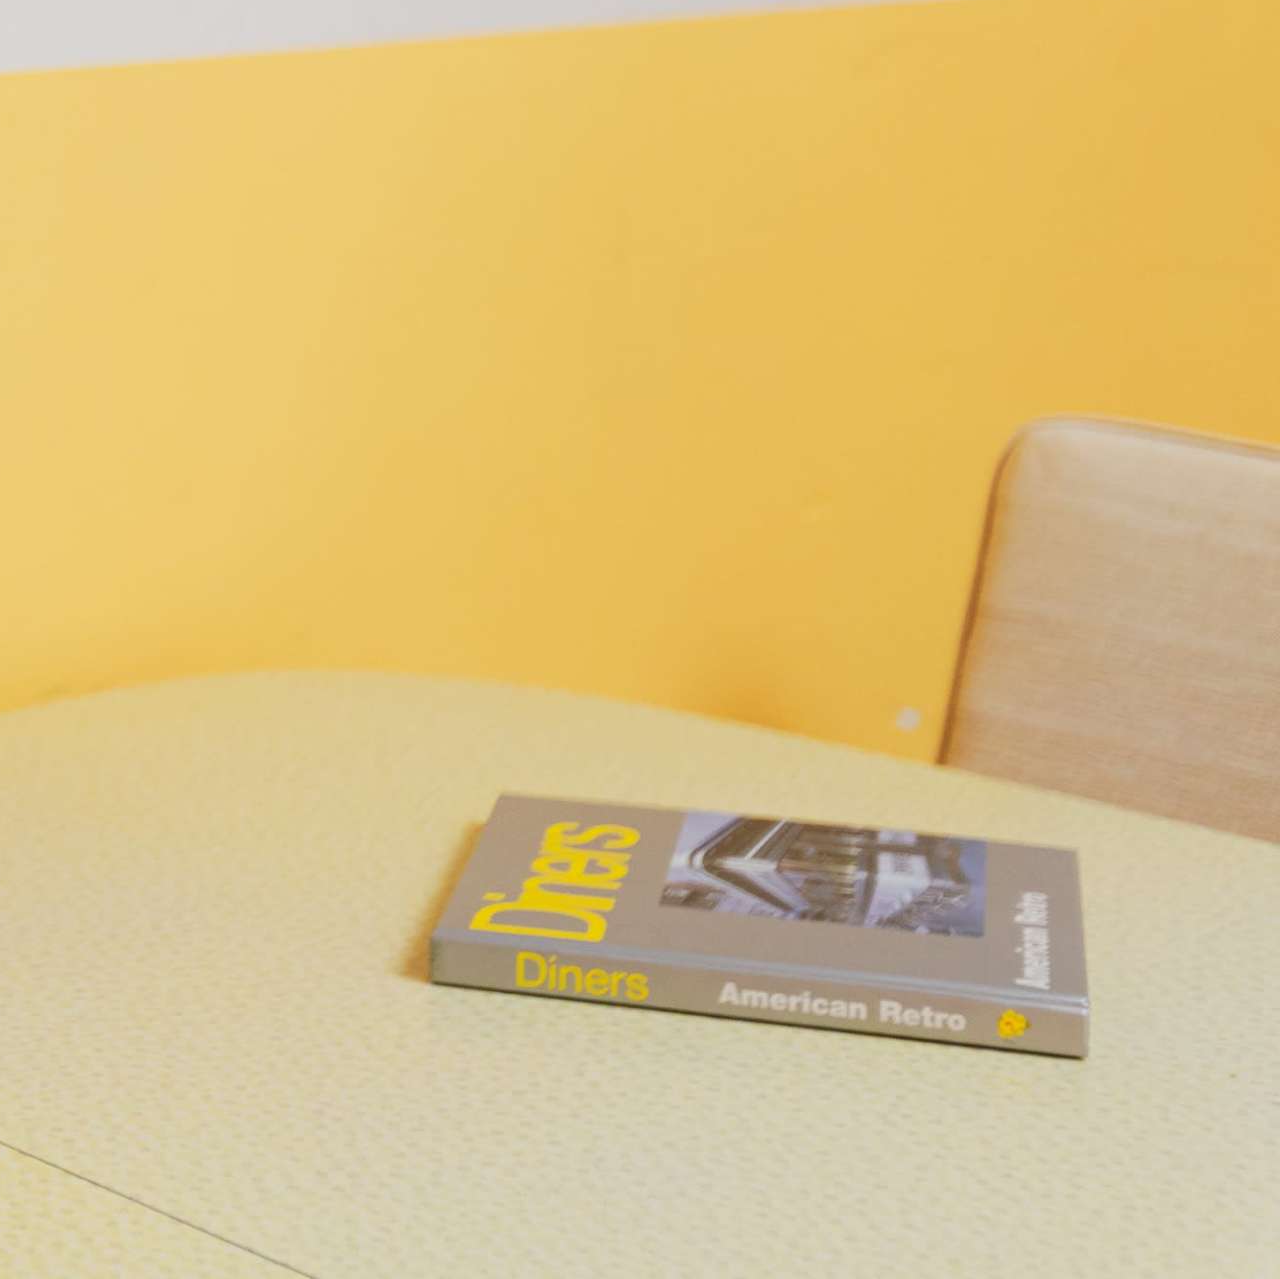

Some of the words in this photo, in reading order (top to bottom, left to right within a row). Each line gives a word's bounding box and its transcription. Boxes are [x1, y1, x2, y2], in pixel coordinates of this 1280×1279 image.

[468, 820, 641, 943] Diners
[514, 951, 650, 1001] Diners
[718, 981, 869, 1021] American
[877, 1000, 967, 1032] Retro
